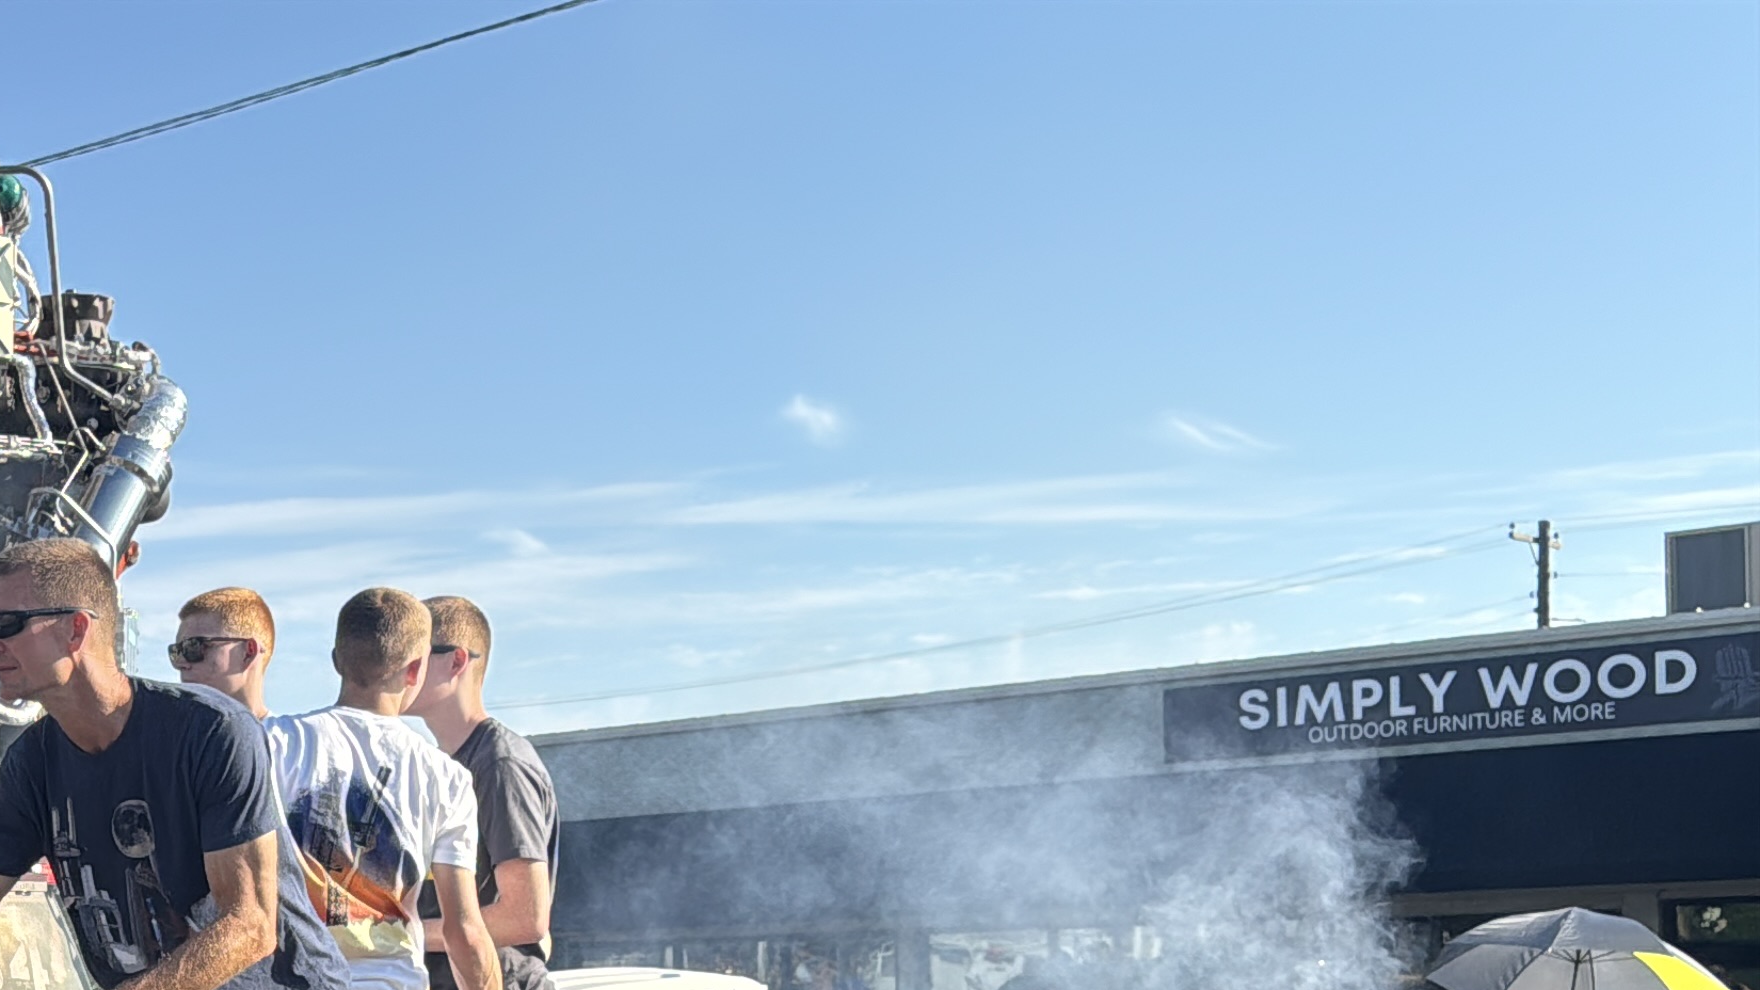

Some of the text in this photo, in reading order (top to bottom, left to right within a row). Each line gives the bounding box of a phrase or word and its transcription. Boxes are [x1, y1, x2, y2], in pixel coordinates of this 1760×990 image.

[1239, 649, 1697, 730] SIMPLY WOOD
[1308, 701, 1617, 744] OUTDOOR FURNITURE & MORE
